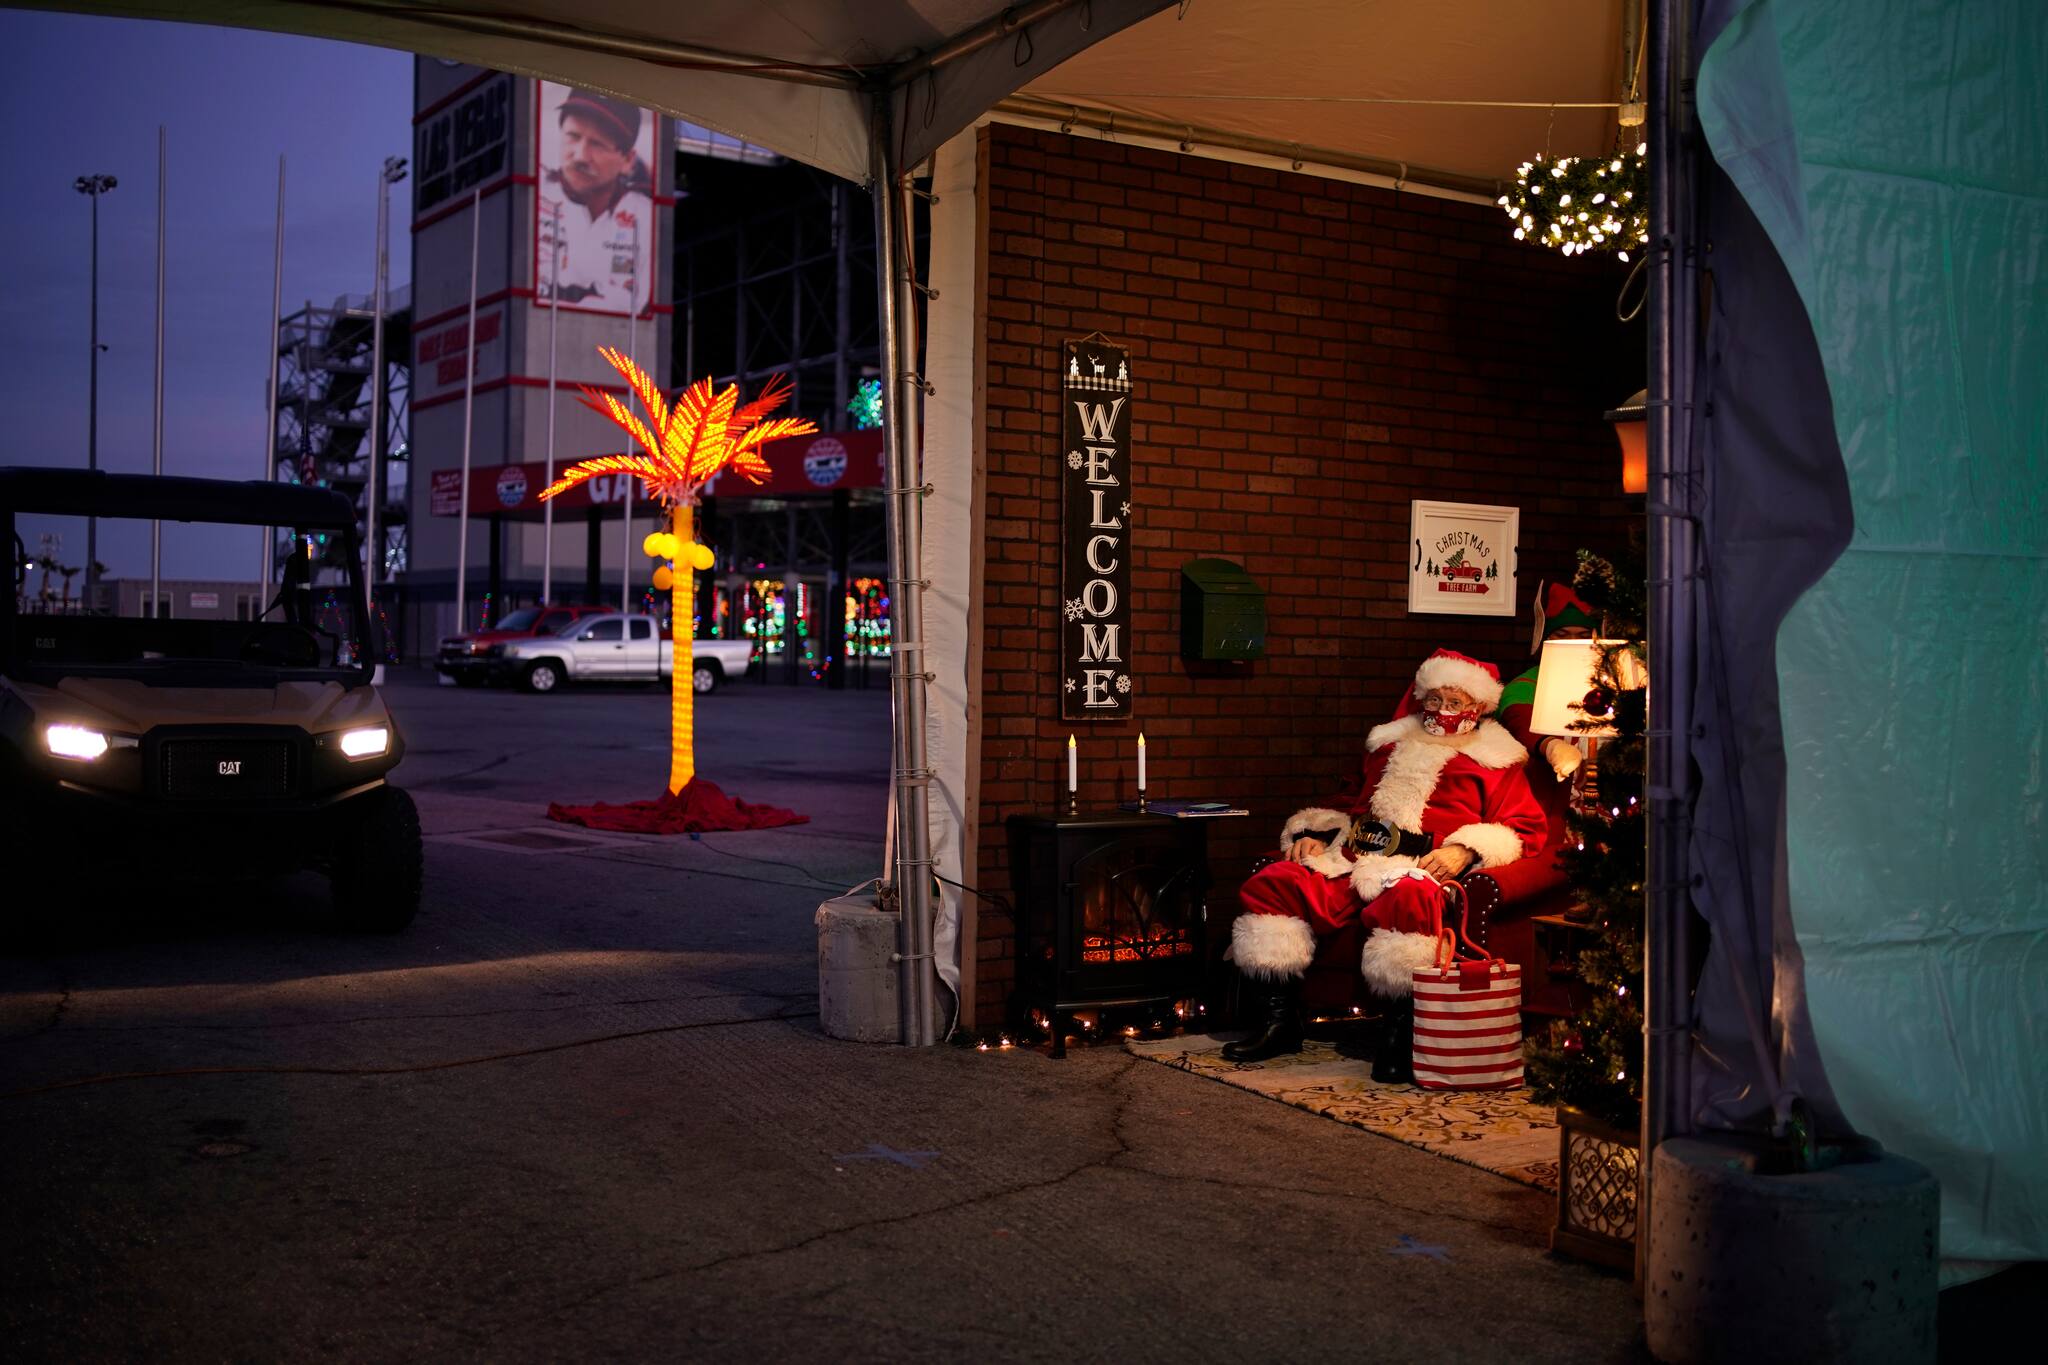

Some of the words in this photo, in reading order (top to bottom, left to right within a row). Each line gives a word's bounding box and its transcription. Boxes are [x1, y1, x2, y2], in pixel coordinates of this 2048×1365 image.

[420, 114, 450, 182] LAS
[453, 79, 507, 163] VEGAS
[1074, 396, 1127, 708] WELCOME
[1436, 531, 1490, 557] CHRISTMAS
[1446, 583, 1460, 592] TREE
[1461, 583, 1478, 593] FARM
[218, 761, 242, 775] CAT
